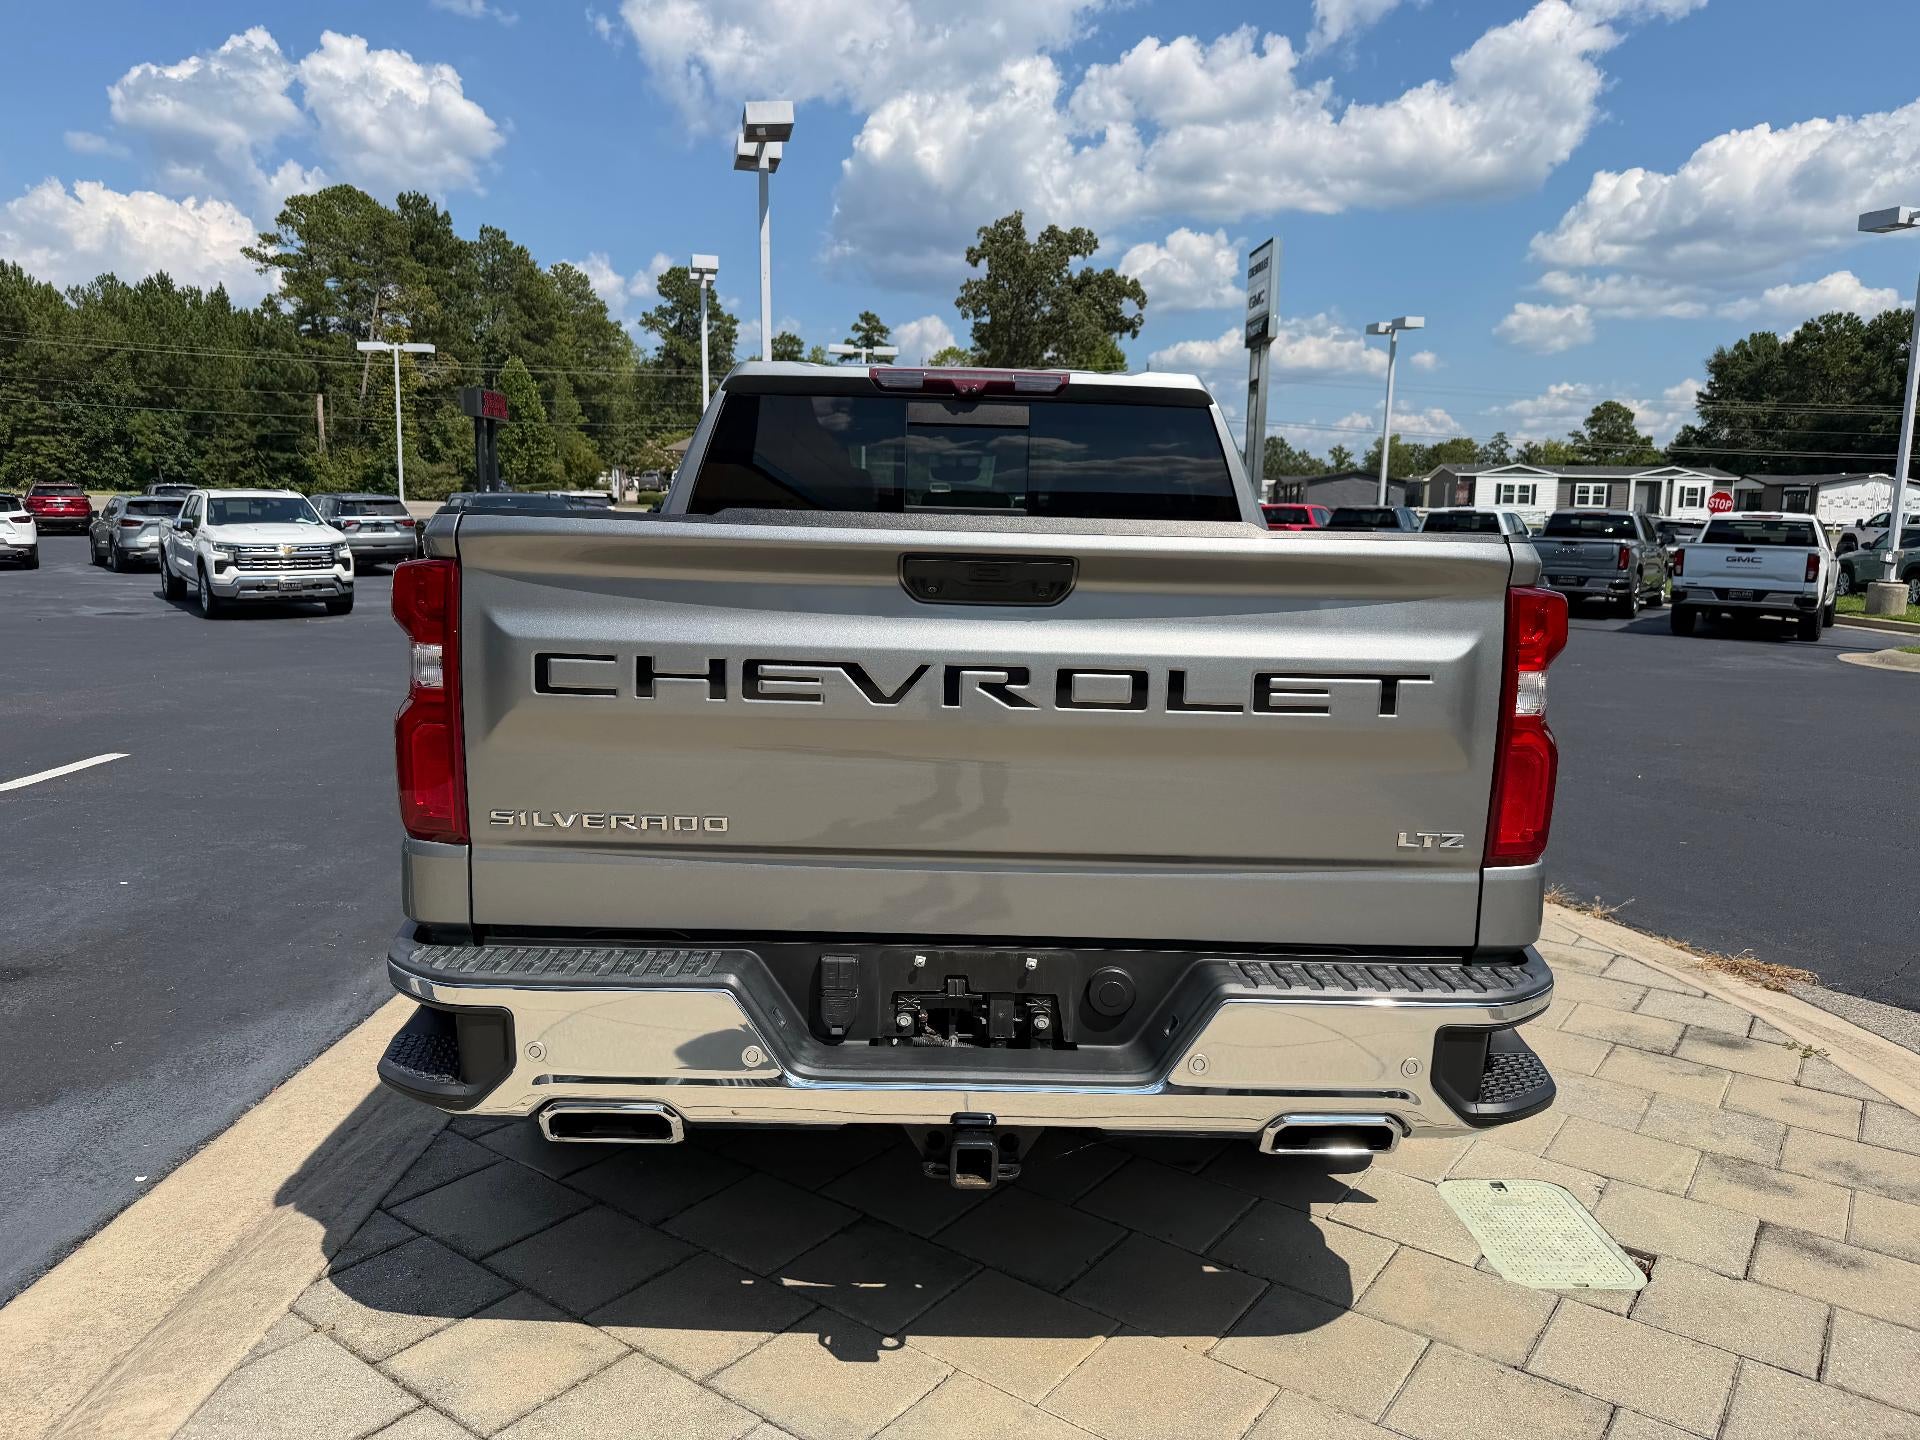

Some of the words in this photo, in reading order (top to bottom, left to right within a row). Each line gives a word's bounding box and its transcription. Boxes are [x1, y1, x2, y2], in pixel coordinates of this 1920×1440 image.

[1248, 289, 1265, 309] GMC
[1708, 497, 1732, 510] STOP
[532, 652, 1434, 718] CHEVROLET
[489, 809, 729, 832] SILVERADO
[1396, 832, 1465, 848] LTZ
